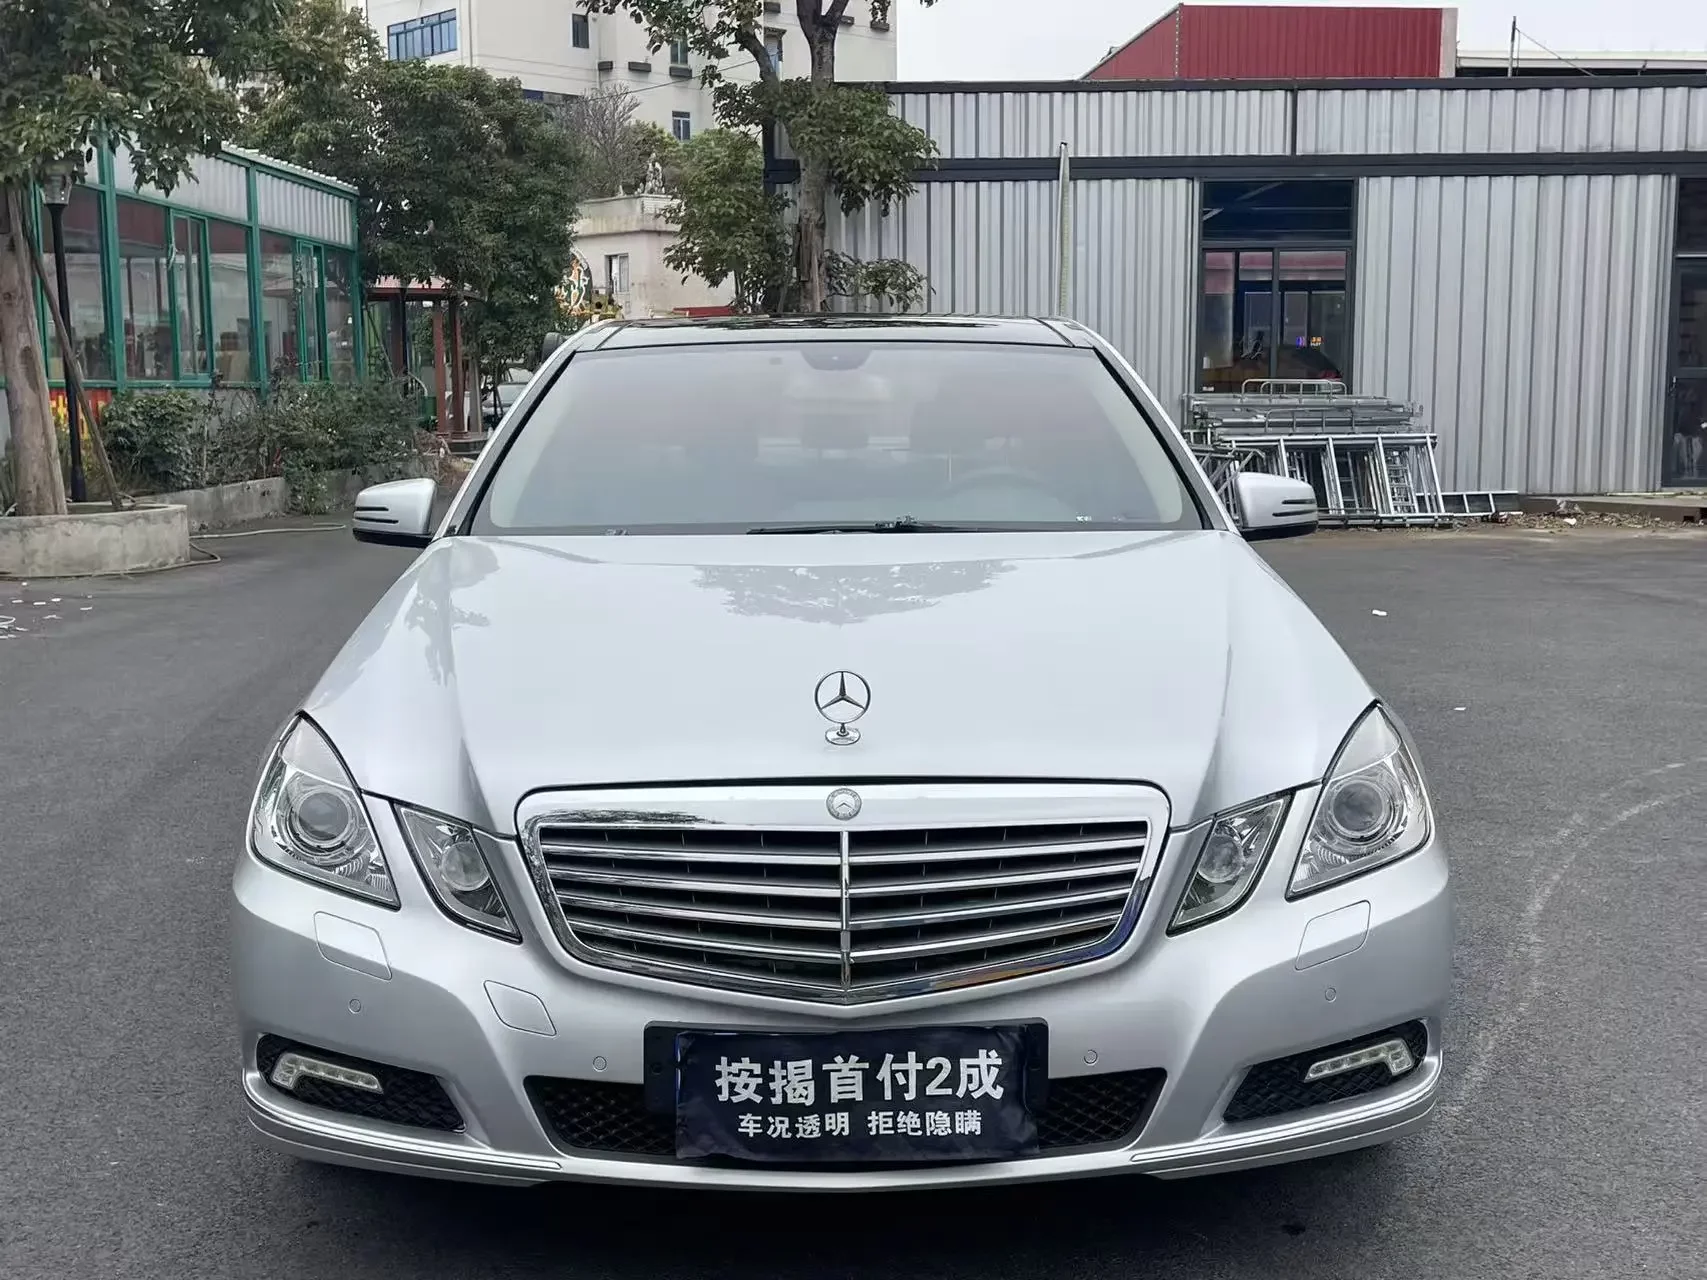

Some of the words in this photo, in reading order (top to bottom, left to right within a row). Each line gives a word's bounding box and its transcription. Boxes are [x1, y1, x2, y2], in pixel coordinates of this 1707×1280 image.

[714, 1048, 1004, 1106] 按揭首付2成
[737, 1111, 850, 1139] 车况透明
[867, 1109, 982, 1137] 拒绝隐瞒
